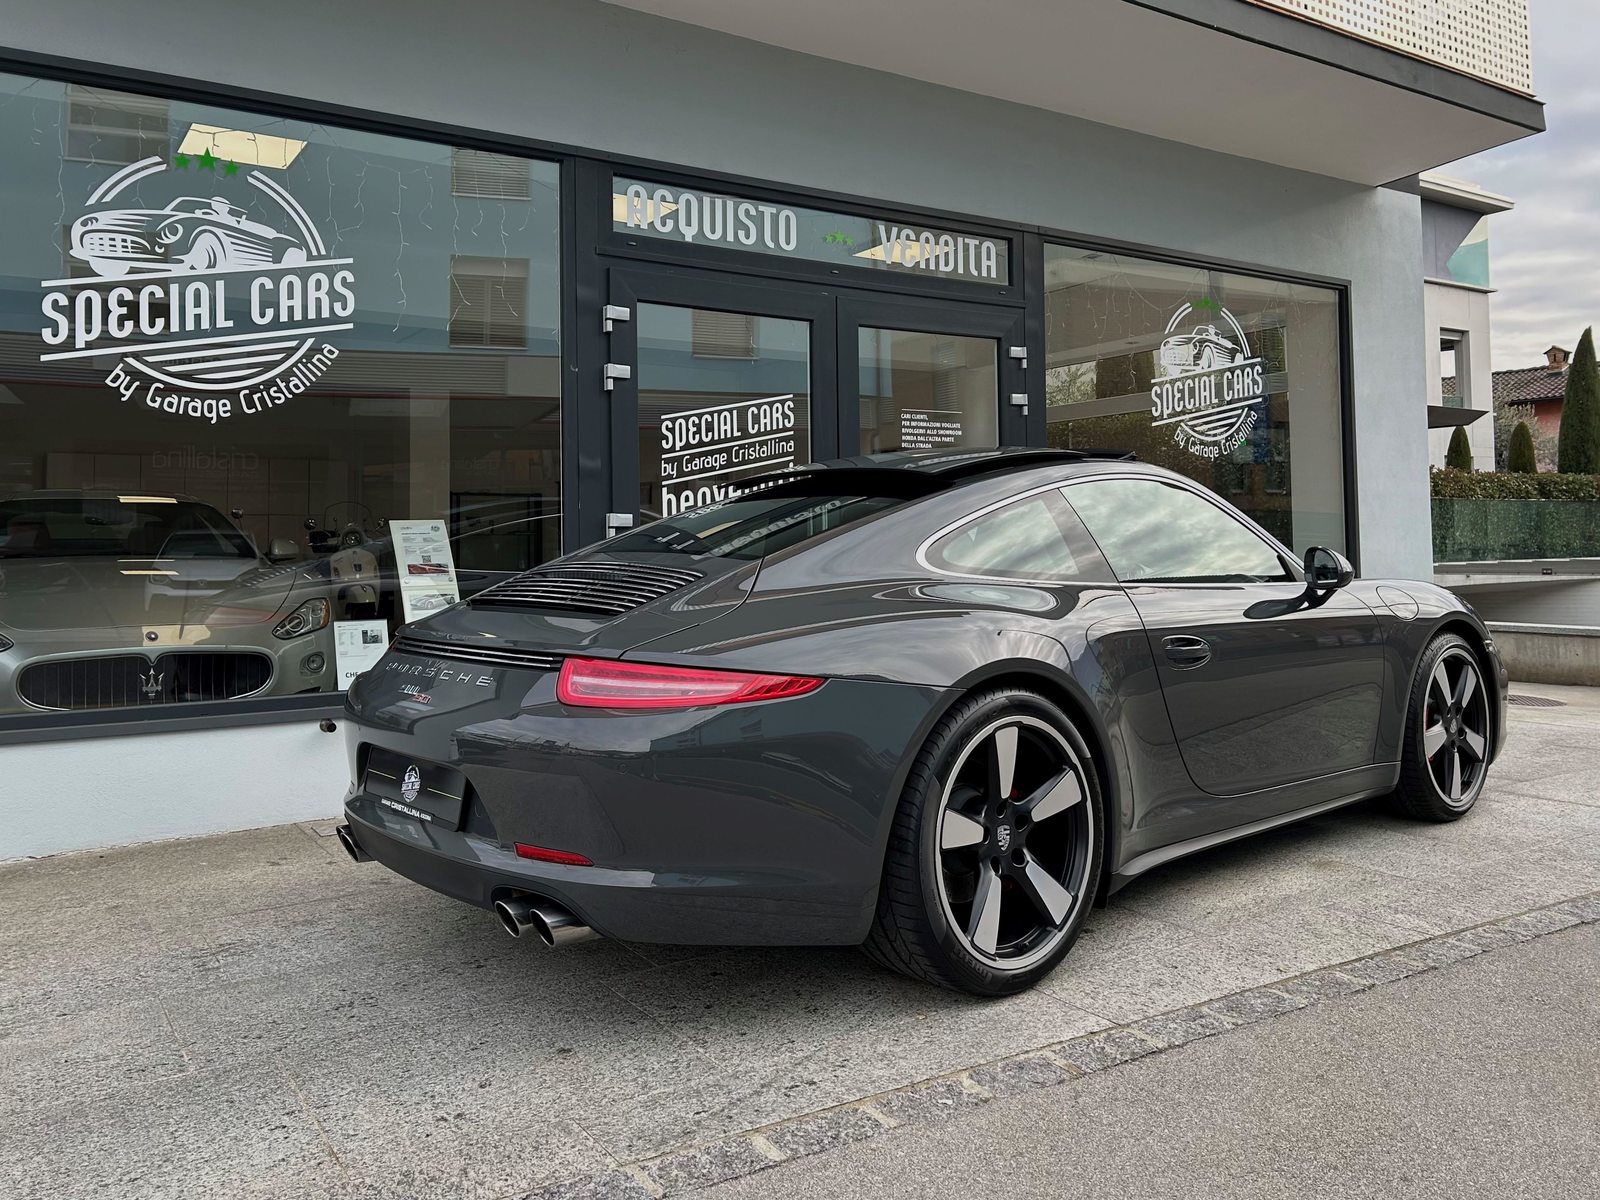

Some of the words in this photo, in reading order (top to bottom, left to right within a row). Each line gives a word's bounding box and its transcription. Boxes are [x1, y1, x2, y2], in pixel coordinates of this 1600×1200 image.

[626, 184, 797, 251] ACQUISTO
[878, 225, 997, 278] VENDITA
[41, 279, 234, 349] SPECIAL
[250, 270, 355, 325] CARS
[105, 363, 140, 402] by
[146, 382, 232, 425] Garage
[239, 343, 340, 415] Cristallina
[1151, 374, 1219, 419] SPECIAL
[1223, 365, 1263, 401] CARS
[661, 409, 742, 451] SPECIAL
[747, 400, 795, 435] CARS
[1173, 426, 1187, 449] by
[1188, 437, 1220, 461] Garage
[1221, 410, 1258, 455] Cristallina
[661, 460, 678, 478] by
[683, 452, 727, 470] Garage
[732, 438, 795, 463] Cristallina
[385, 662, 494, 687] PORSCHE
